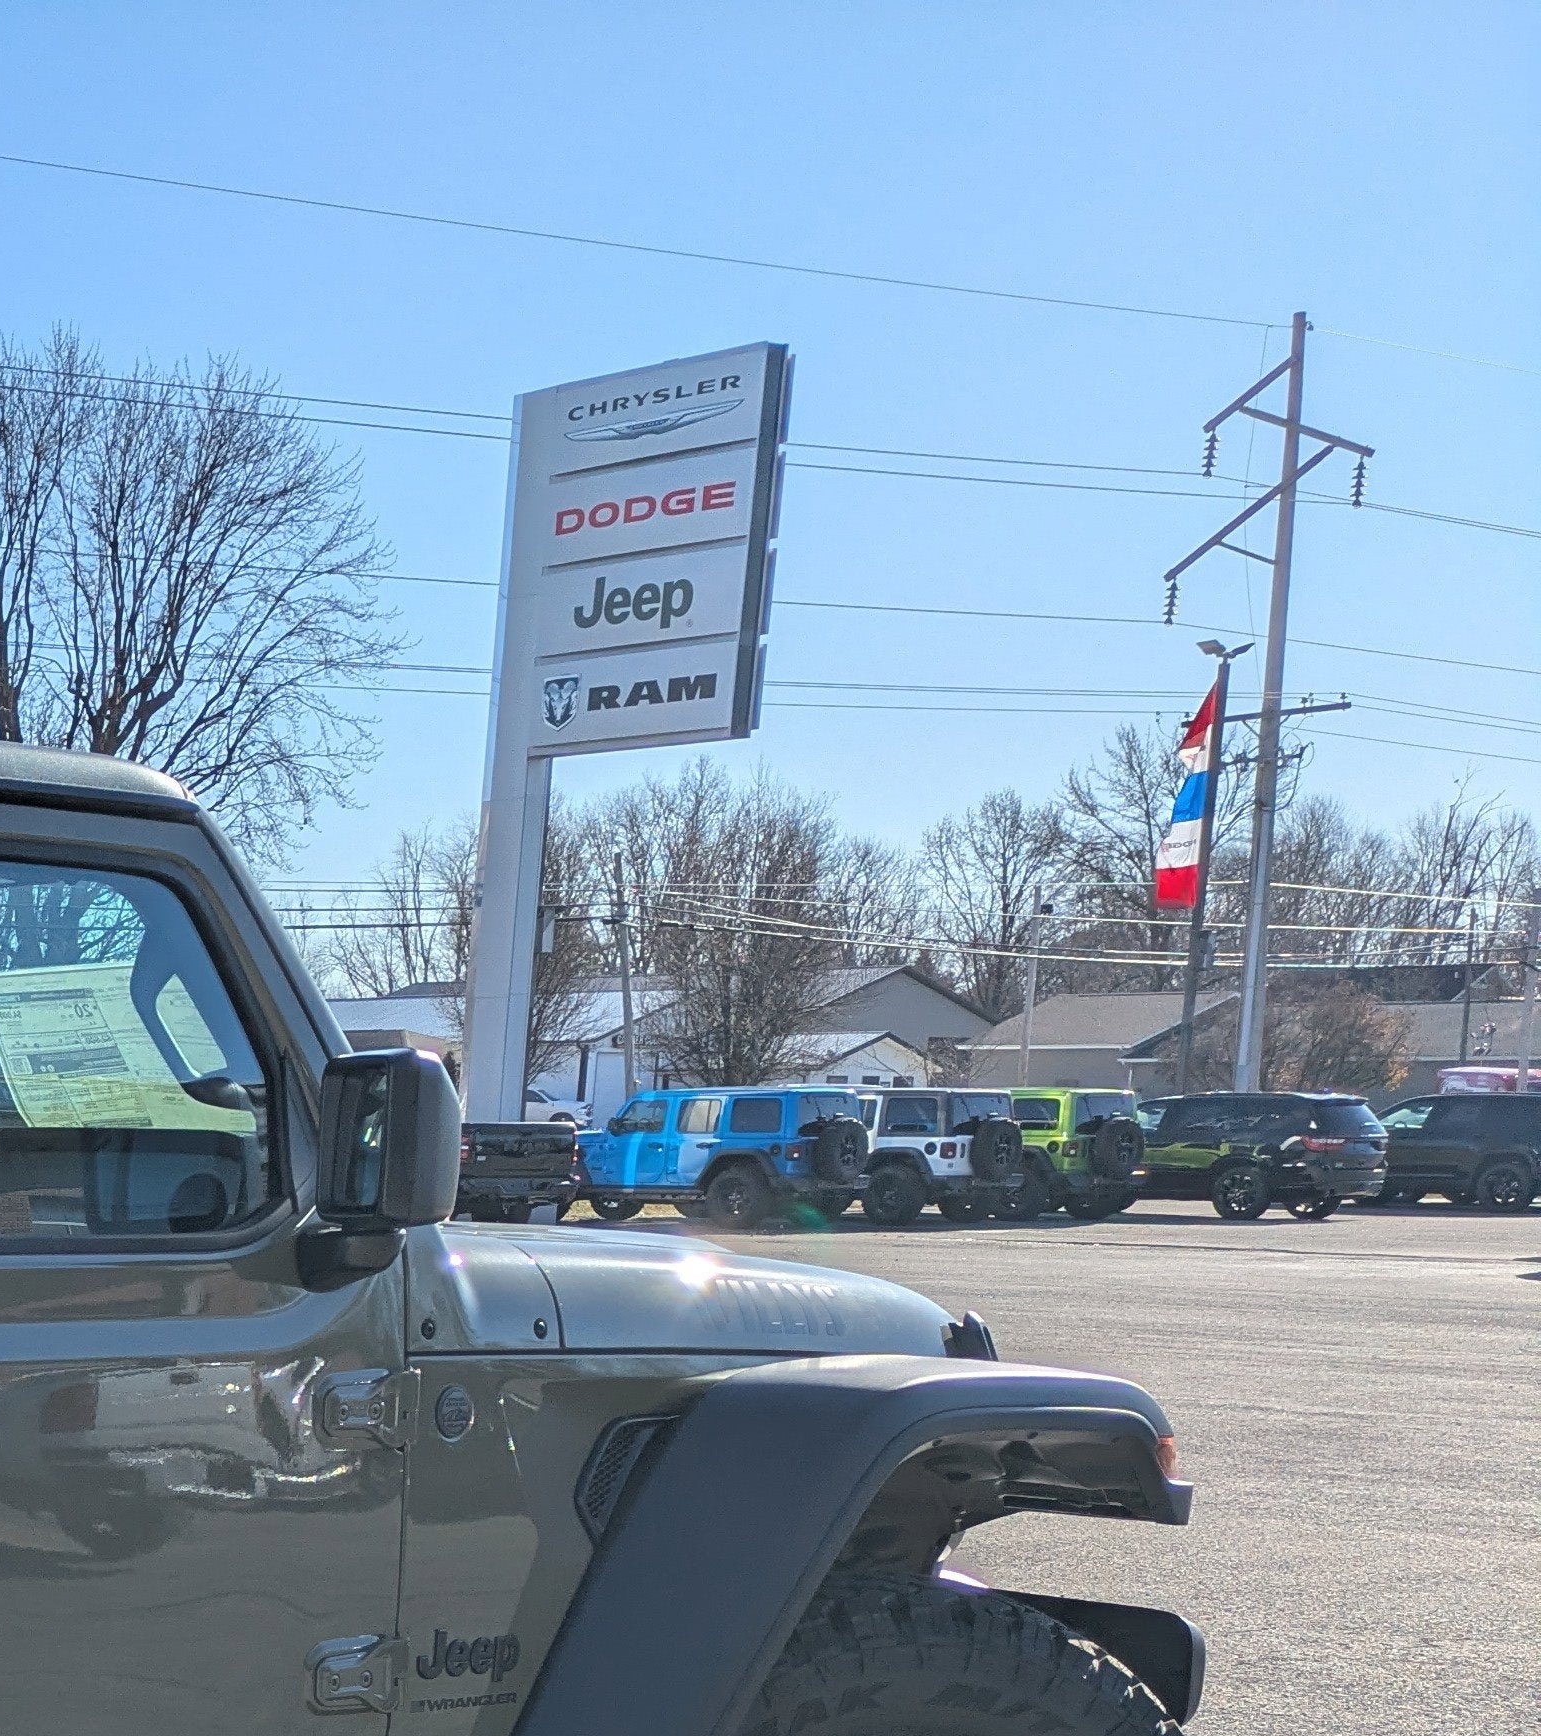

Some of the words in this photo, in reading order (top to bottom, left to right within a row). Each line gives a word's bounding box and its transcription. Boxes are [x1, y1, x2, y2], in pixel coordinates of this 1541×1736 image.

[567, 374, 742, 422] CHRYSLER
[554, 481, 737, 536] DODGE
[573, 575, 694, 629] Jeep
[586, 672, 718, 712] RAM
[416, 1628, 521, 1683] Jeep
[425, 1692, 518, 1713] WRANGLER
